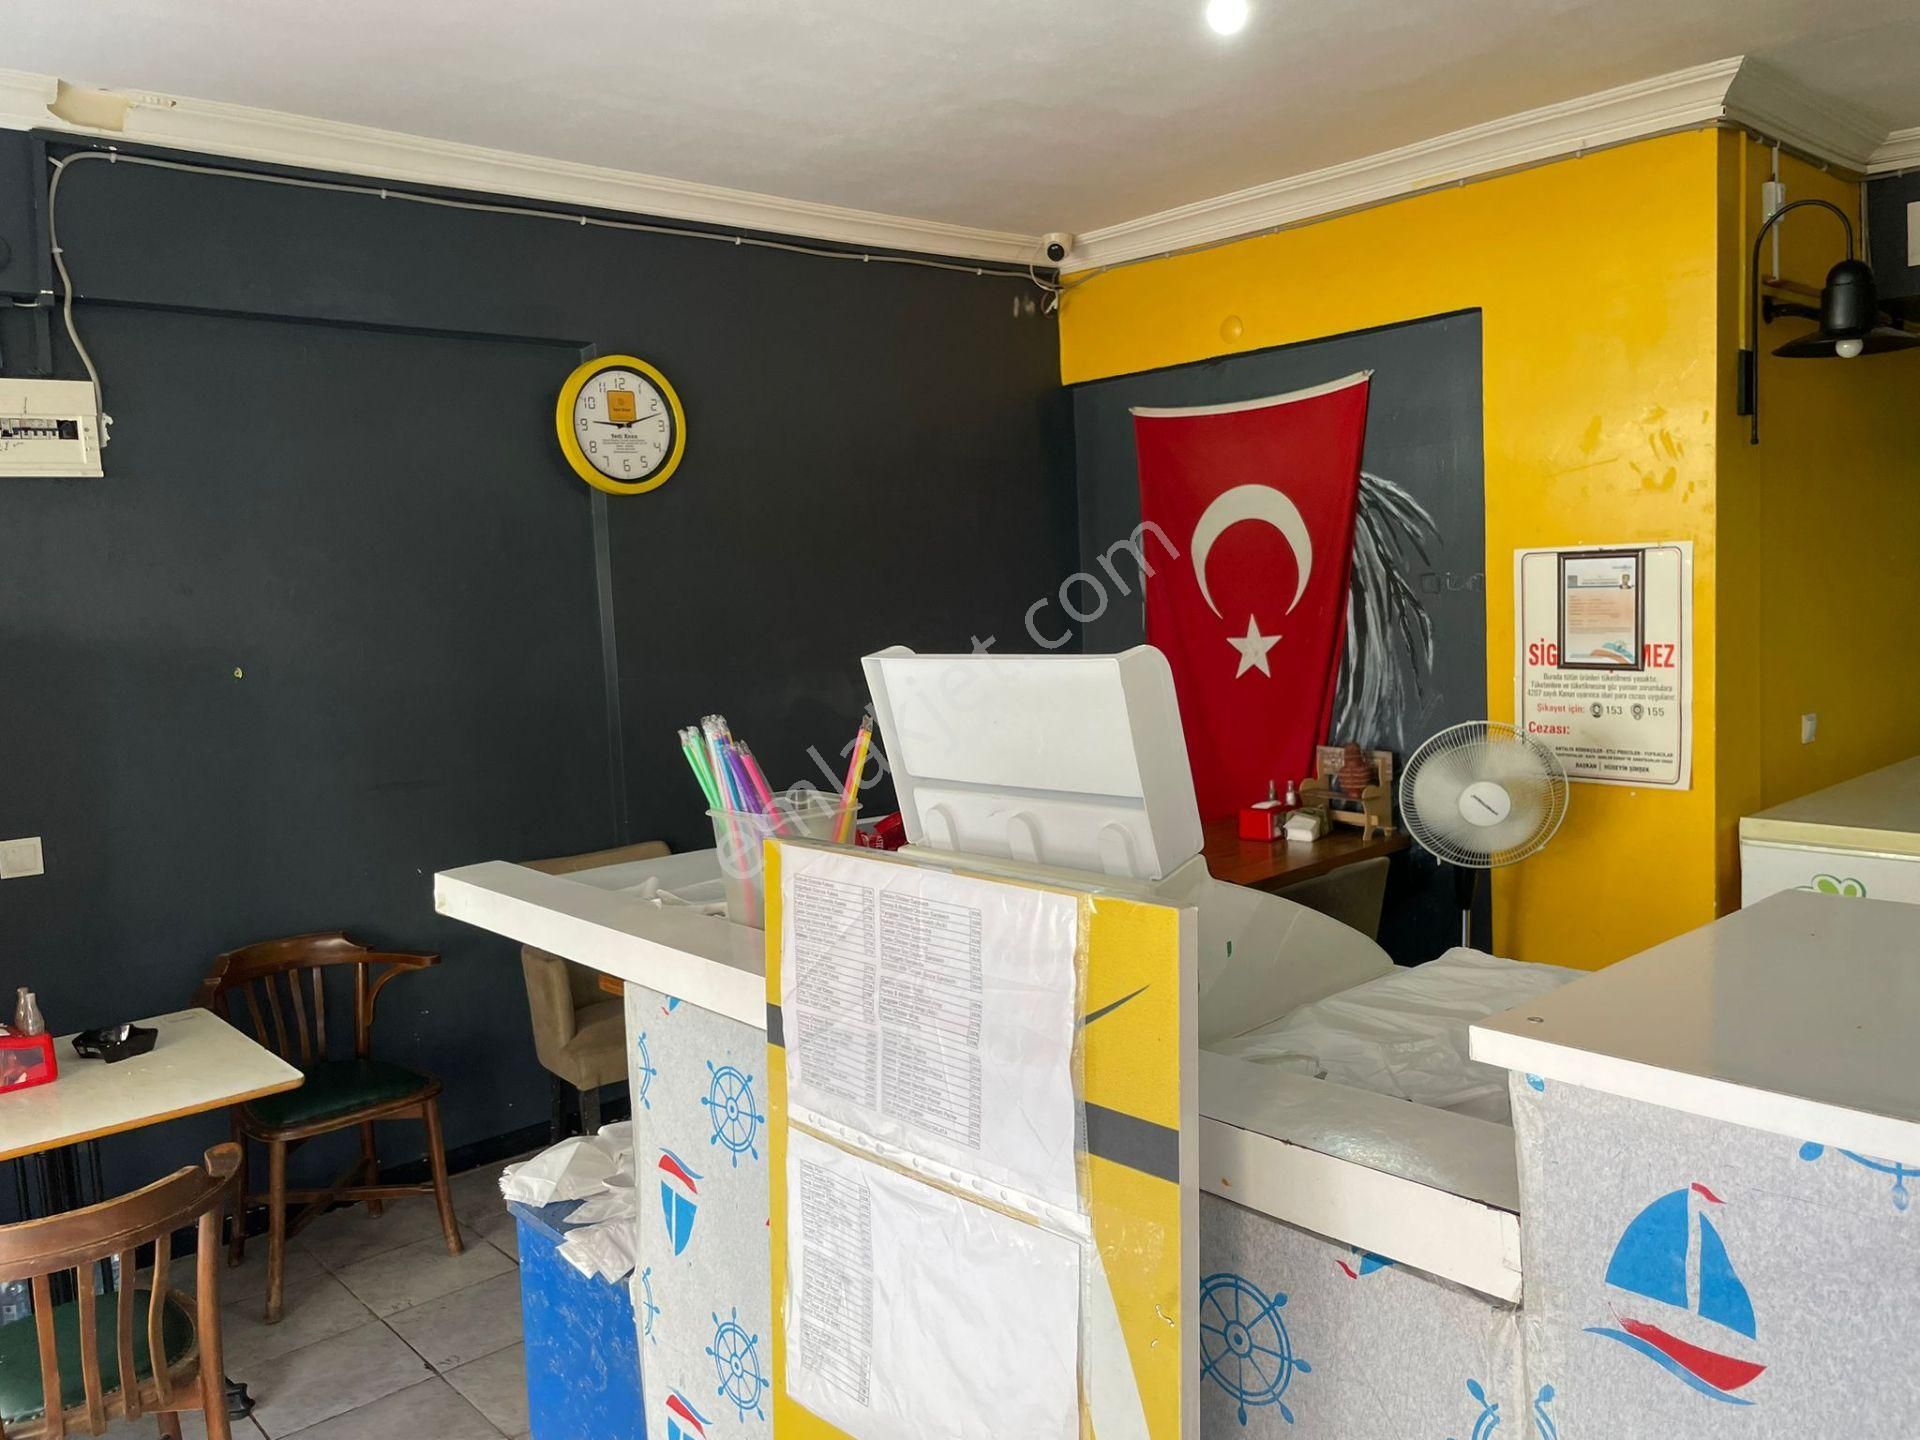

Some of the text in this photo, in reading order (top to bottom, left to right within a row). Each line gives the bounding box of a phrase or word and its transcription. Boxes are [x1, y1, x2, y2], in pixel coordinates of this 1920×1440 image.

[598, 381, 606, 393] 11
[614, 377, 625, 390] 12
[583, 396, 596, 410] 10
[650, 399, 658, 411] 2
[580, 418, 588, 431] 9
[658, 420, 665, 433] 3
[589, 441, 597, 454] 8
[653, 442, 662, 452] 4
[602, 456, 610, 467] 7
[623, 459, 631, 472] 6
[640, 456, 648, 468] 5
[1528, 637, 1559, 667] SİG
[1537, 703, 1566, 714] Şikayet
[1606, 705, 1623, 715] 153
[1647, 707, 1665, 716] 155
[1528, 721, 1571, 734] Cezası:
